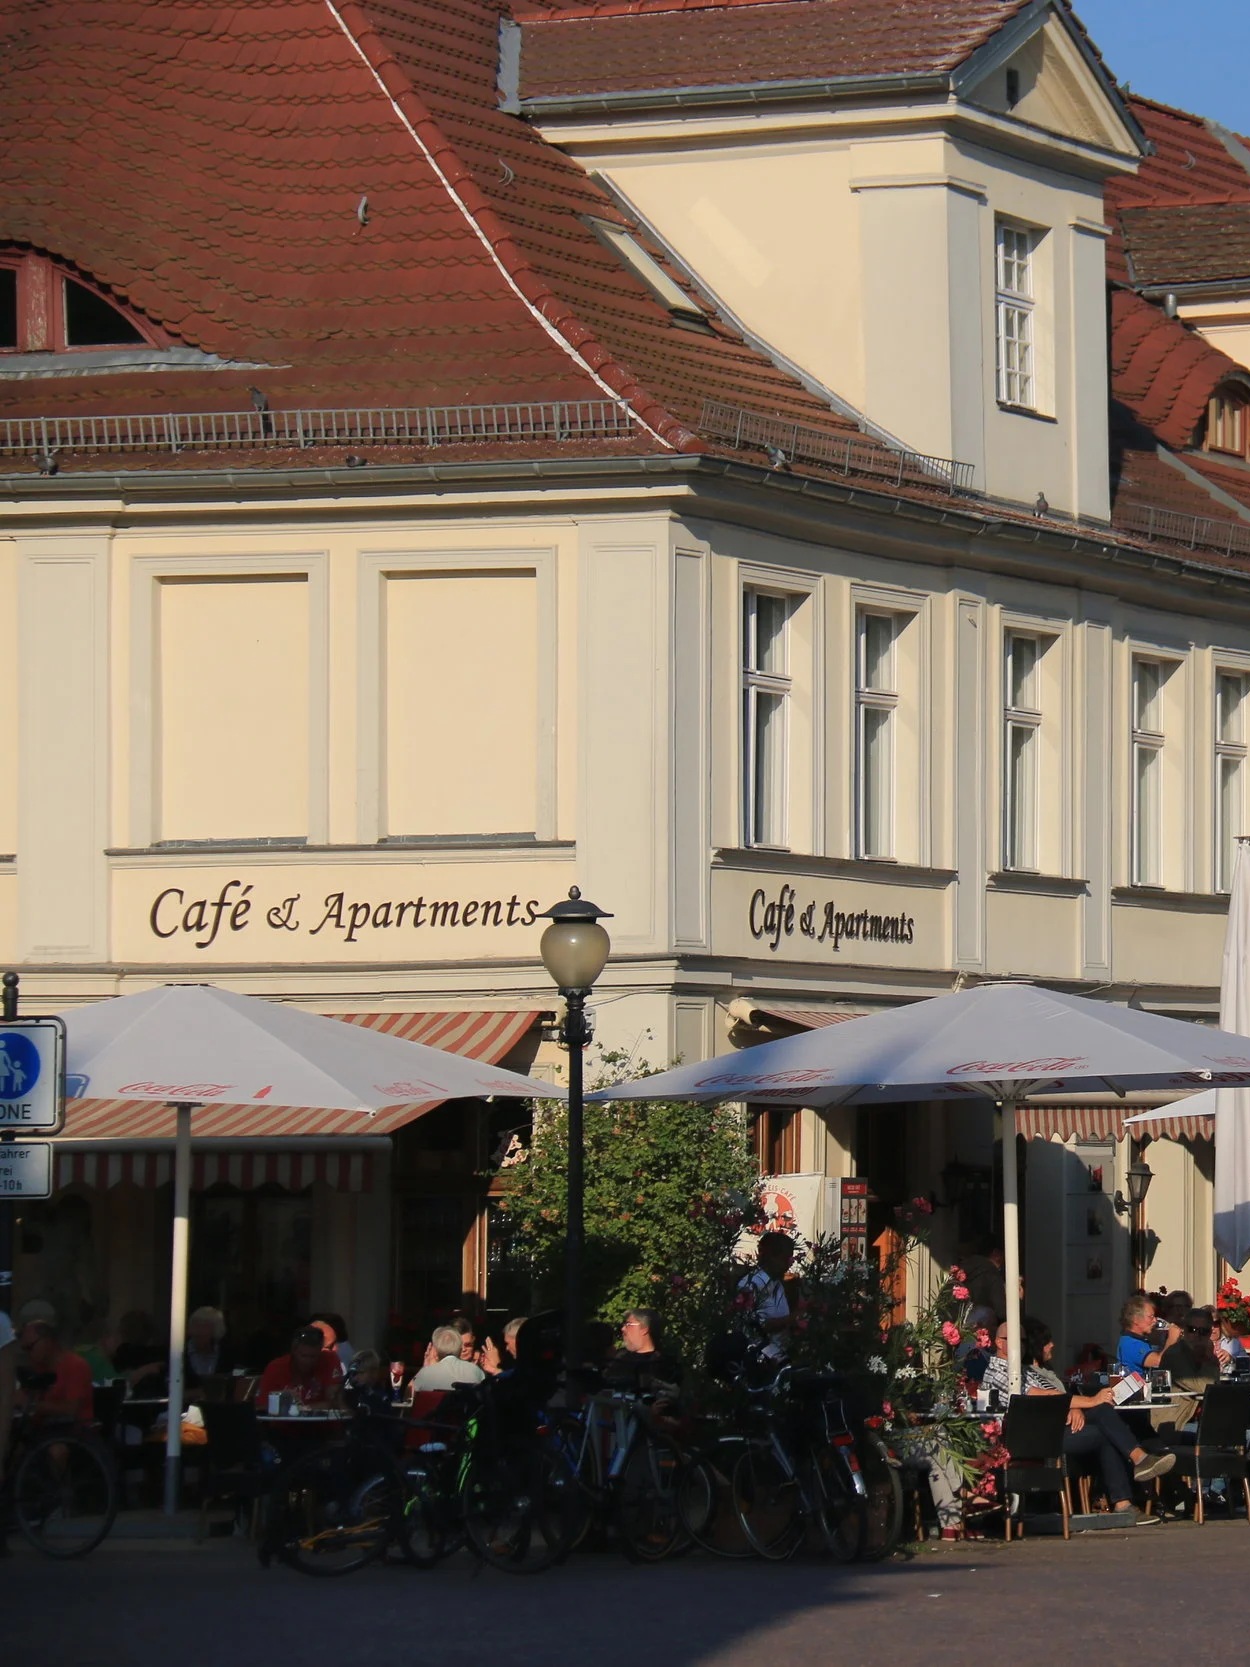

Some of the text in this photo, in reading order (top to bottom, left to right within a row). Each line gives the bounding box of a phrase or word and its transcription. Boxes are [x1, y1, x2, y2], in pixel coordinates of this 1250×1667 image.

[150, 879, 540, 949] Café & Apartments
[749, 883, 914, 952] Café & Apartments
[946, 1056, 1090, 1075] Coca-Cola
[118, 1081, 239, 1097] Coca-Cola
[0, 1149, 31, 1160] ahrer
